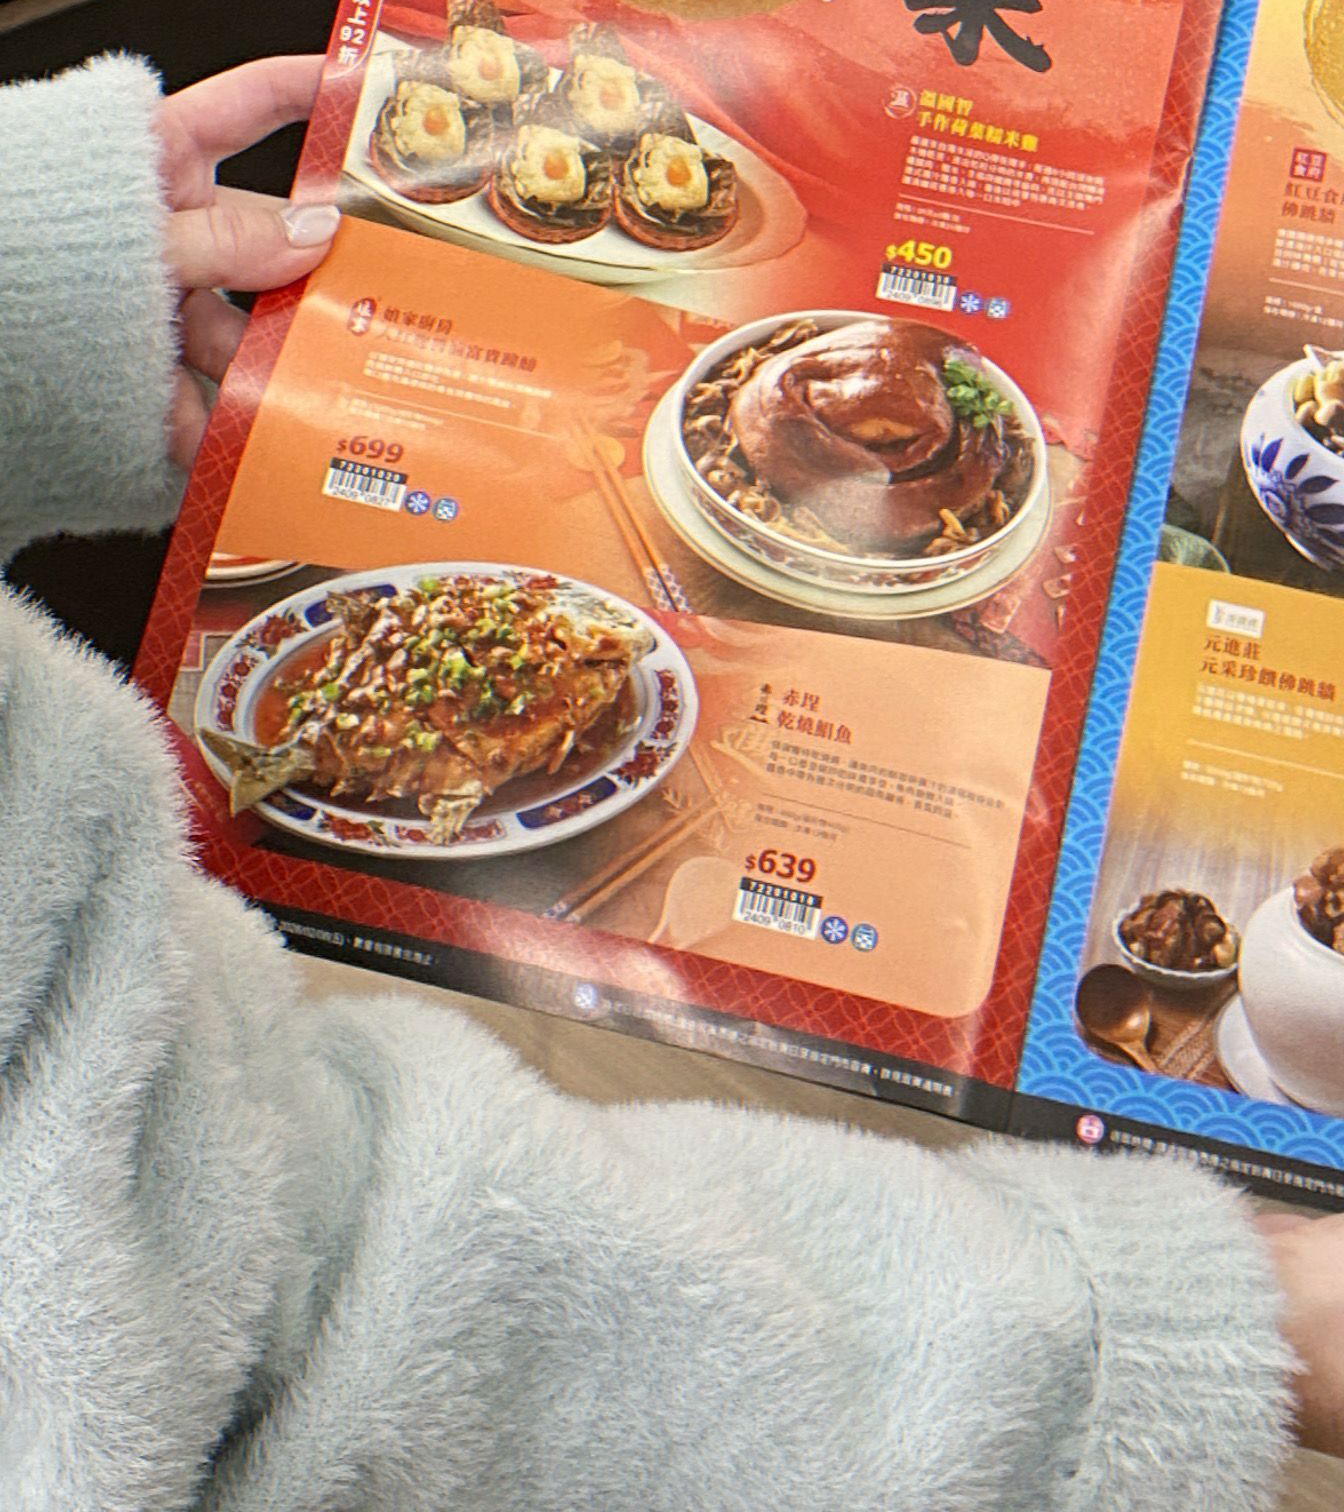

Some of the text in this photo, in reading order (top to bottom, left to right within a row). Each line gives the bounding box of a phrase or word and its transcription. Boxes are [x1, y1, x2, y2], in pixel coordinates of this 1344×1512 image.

[885, 239, 953, 270] $450
[336, 435, 405, 464] $699
[745, 849, 817, 883] $639
